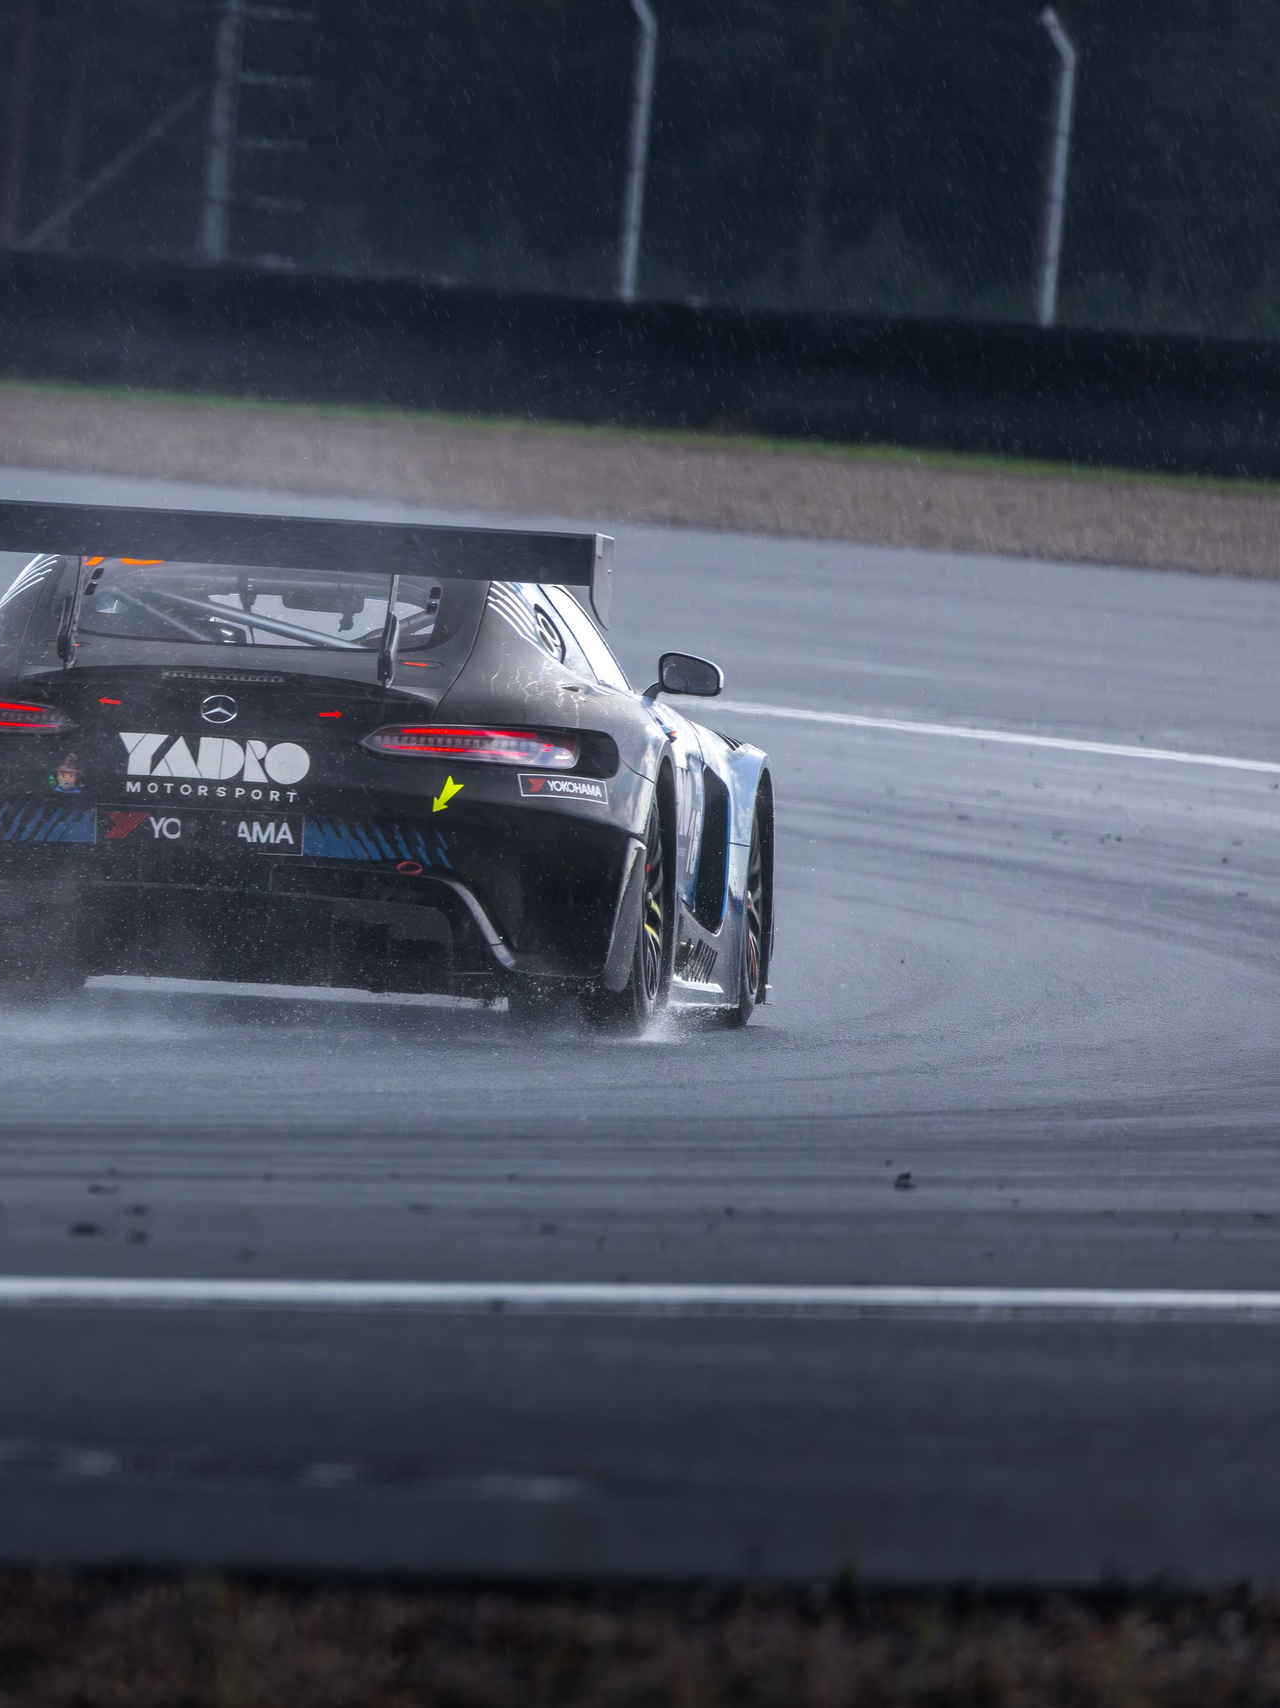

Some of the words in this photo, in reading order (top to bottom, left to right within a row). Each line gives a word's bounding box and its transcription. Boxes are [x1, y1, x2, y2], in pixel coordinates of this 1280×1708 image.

[119, 732, 310, 784] YADRO
[126, 782, 298, 802] MOTORSPORT
[547, 780, 602, 797] YOKOHAMA
